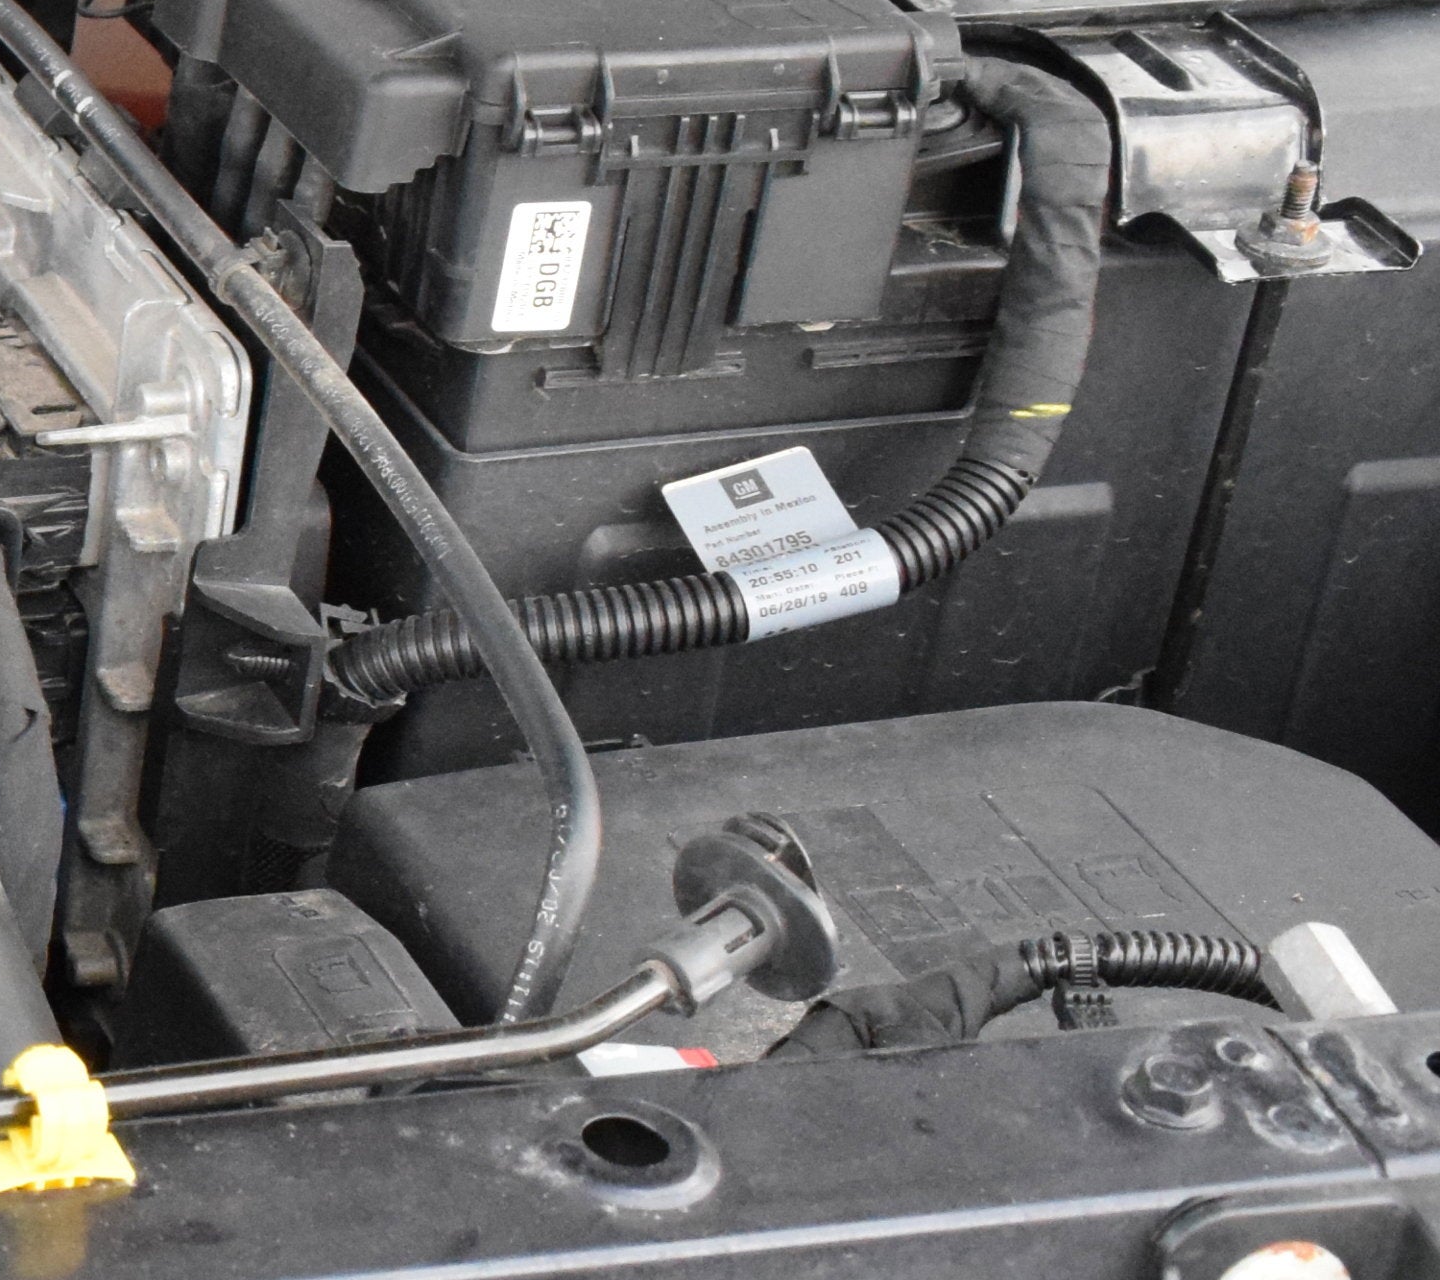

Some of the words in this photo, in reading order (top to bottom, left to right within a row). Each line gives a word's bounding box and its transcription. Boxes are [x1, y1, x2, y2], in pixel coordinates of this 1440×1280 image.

[533, 263, 560, 308] DGB
[732, 478, 760, 497] GM
[715, 531, 813, 569] 84301795
[749, 562, 819, 588] 20:55:10
[834, 550, 863, 566] 201
[758, 592, 829, 618] 06/28/19
[839, 581, 869, 599] 409
